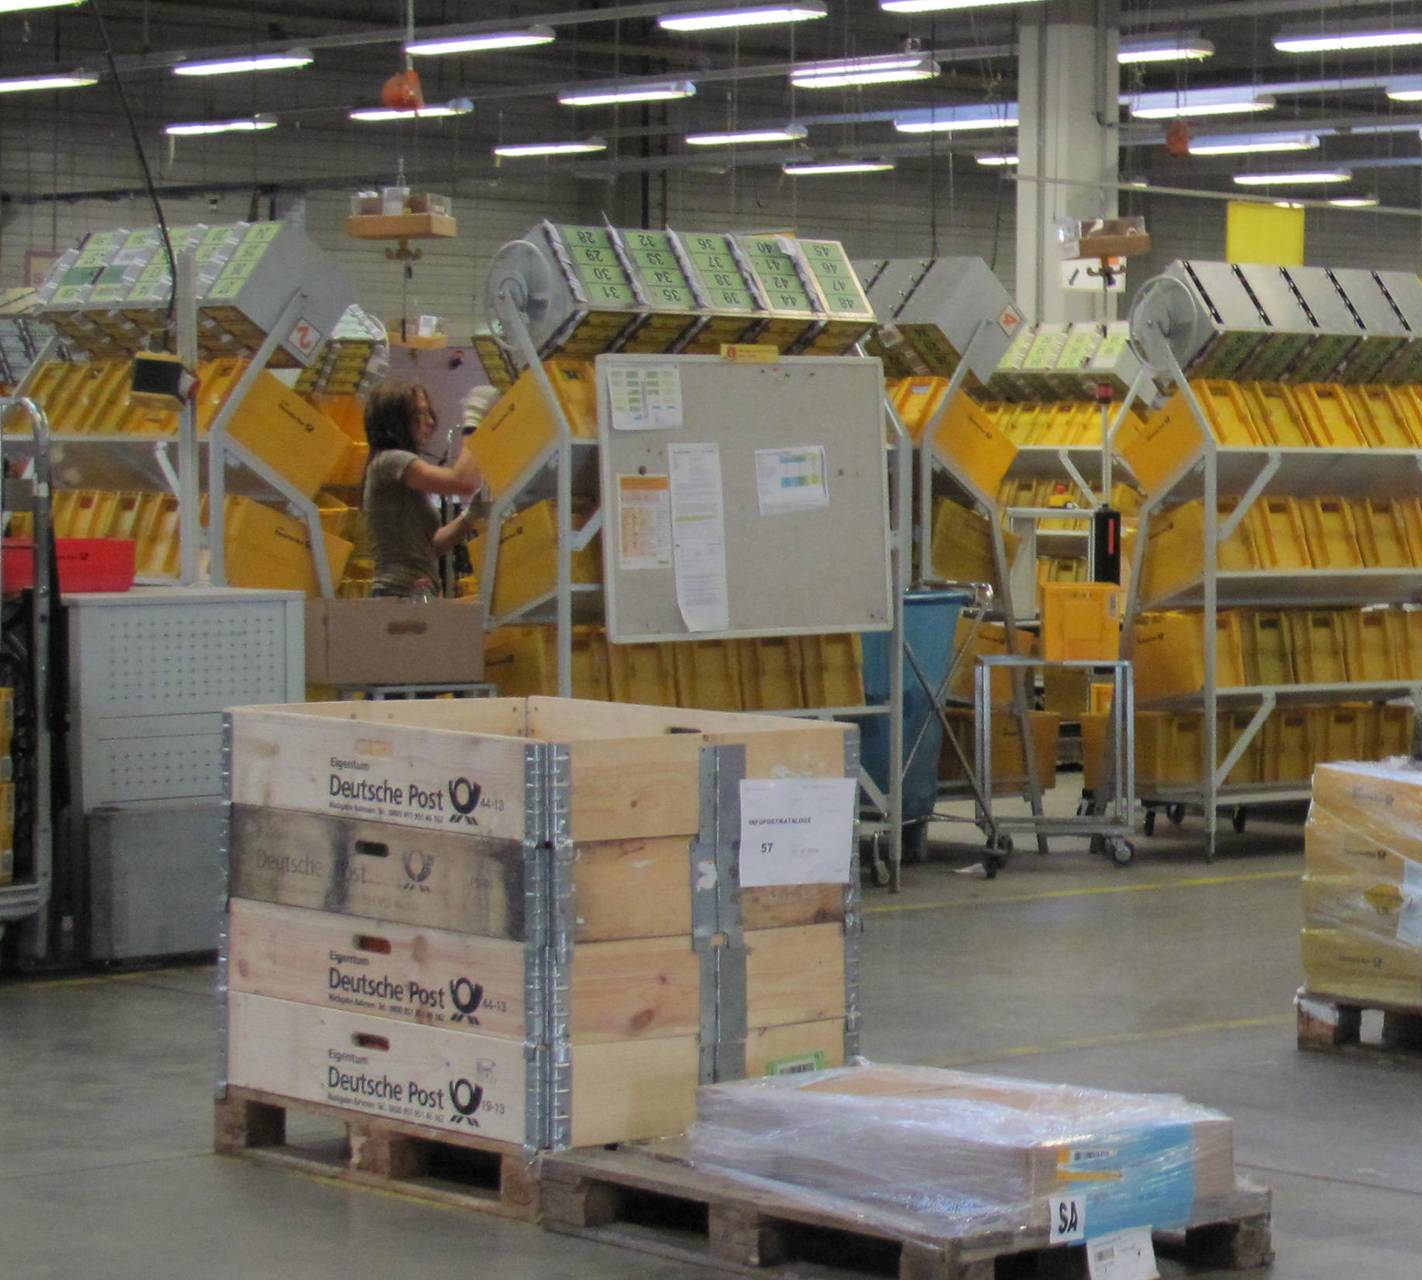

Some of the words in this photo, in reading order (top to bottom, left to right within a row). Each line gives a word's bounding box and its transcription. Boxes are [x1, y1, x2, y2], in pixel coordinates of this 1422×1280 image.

[577, 231, 595, 244] 28
[638, 234, 656, 247] 32
[698, 238, 716, 250] 36
[586, 249, 604, 262] 29
[646, 252, 664, 265] 33
[709, 256, 725, 268] 37
[766, 259, 781, 271] 41
[594, 267, 612, 280] 30
[654, 271, 672, 283] 34
[715, 273, 731, 286] 38
[774, 277, 789, 289] 42
[602, 286, 620, 299] 31
[663, 288, 681, 302] 35
[723, 292, 739, 304] 39
[329, 756, 370, 771] Eigentum
[329, 774, 403, 805] Deutsche
[408, 784, 443, 811] Post
[760, 842, 774, 854] 57
[256, 848, 322, 876] Deutsche
[329, 950, 369, 965] Eigentum
[329, 967, 403, 1001] Deutsche
[409, 981, 445, 1009] Post
[328, 1049, 368, 1065] Eigentum
[328, 1066, 402, 1101] Deutsche
[408, 1082, 444, 1110] Post
[1059, 1202, 1078, 1233] SA
